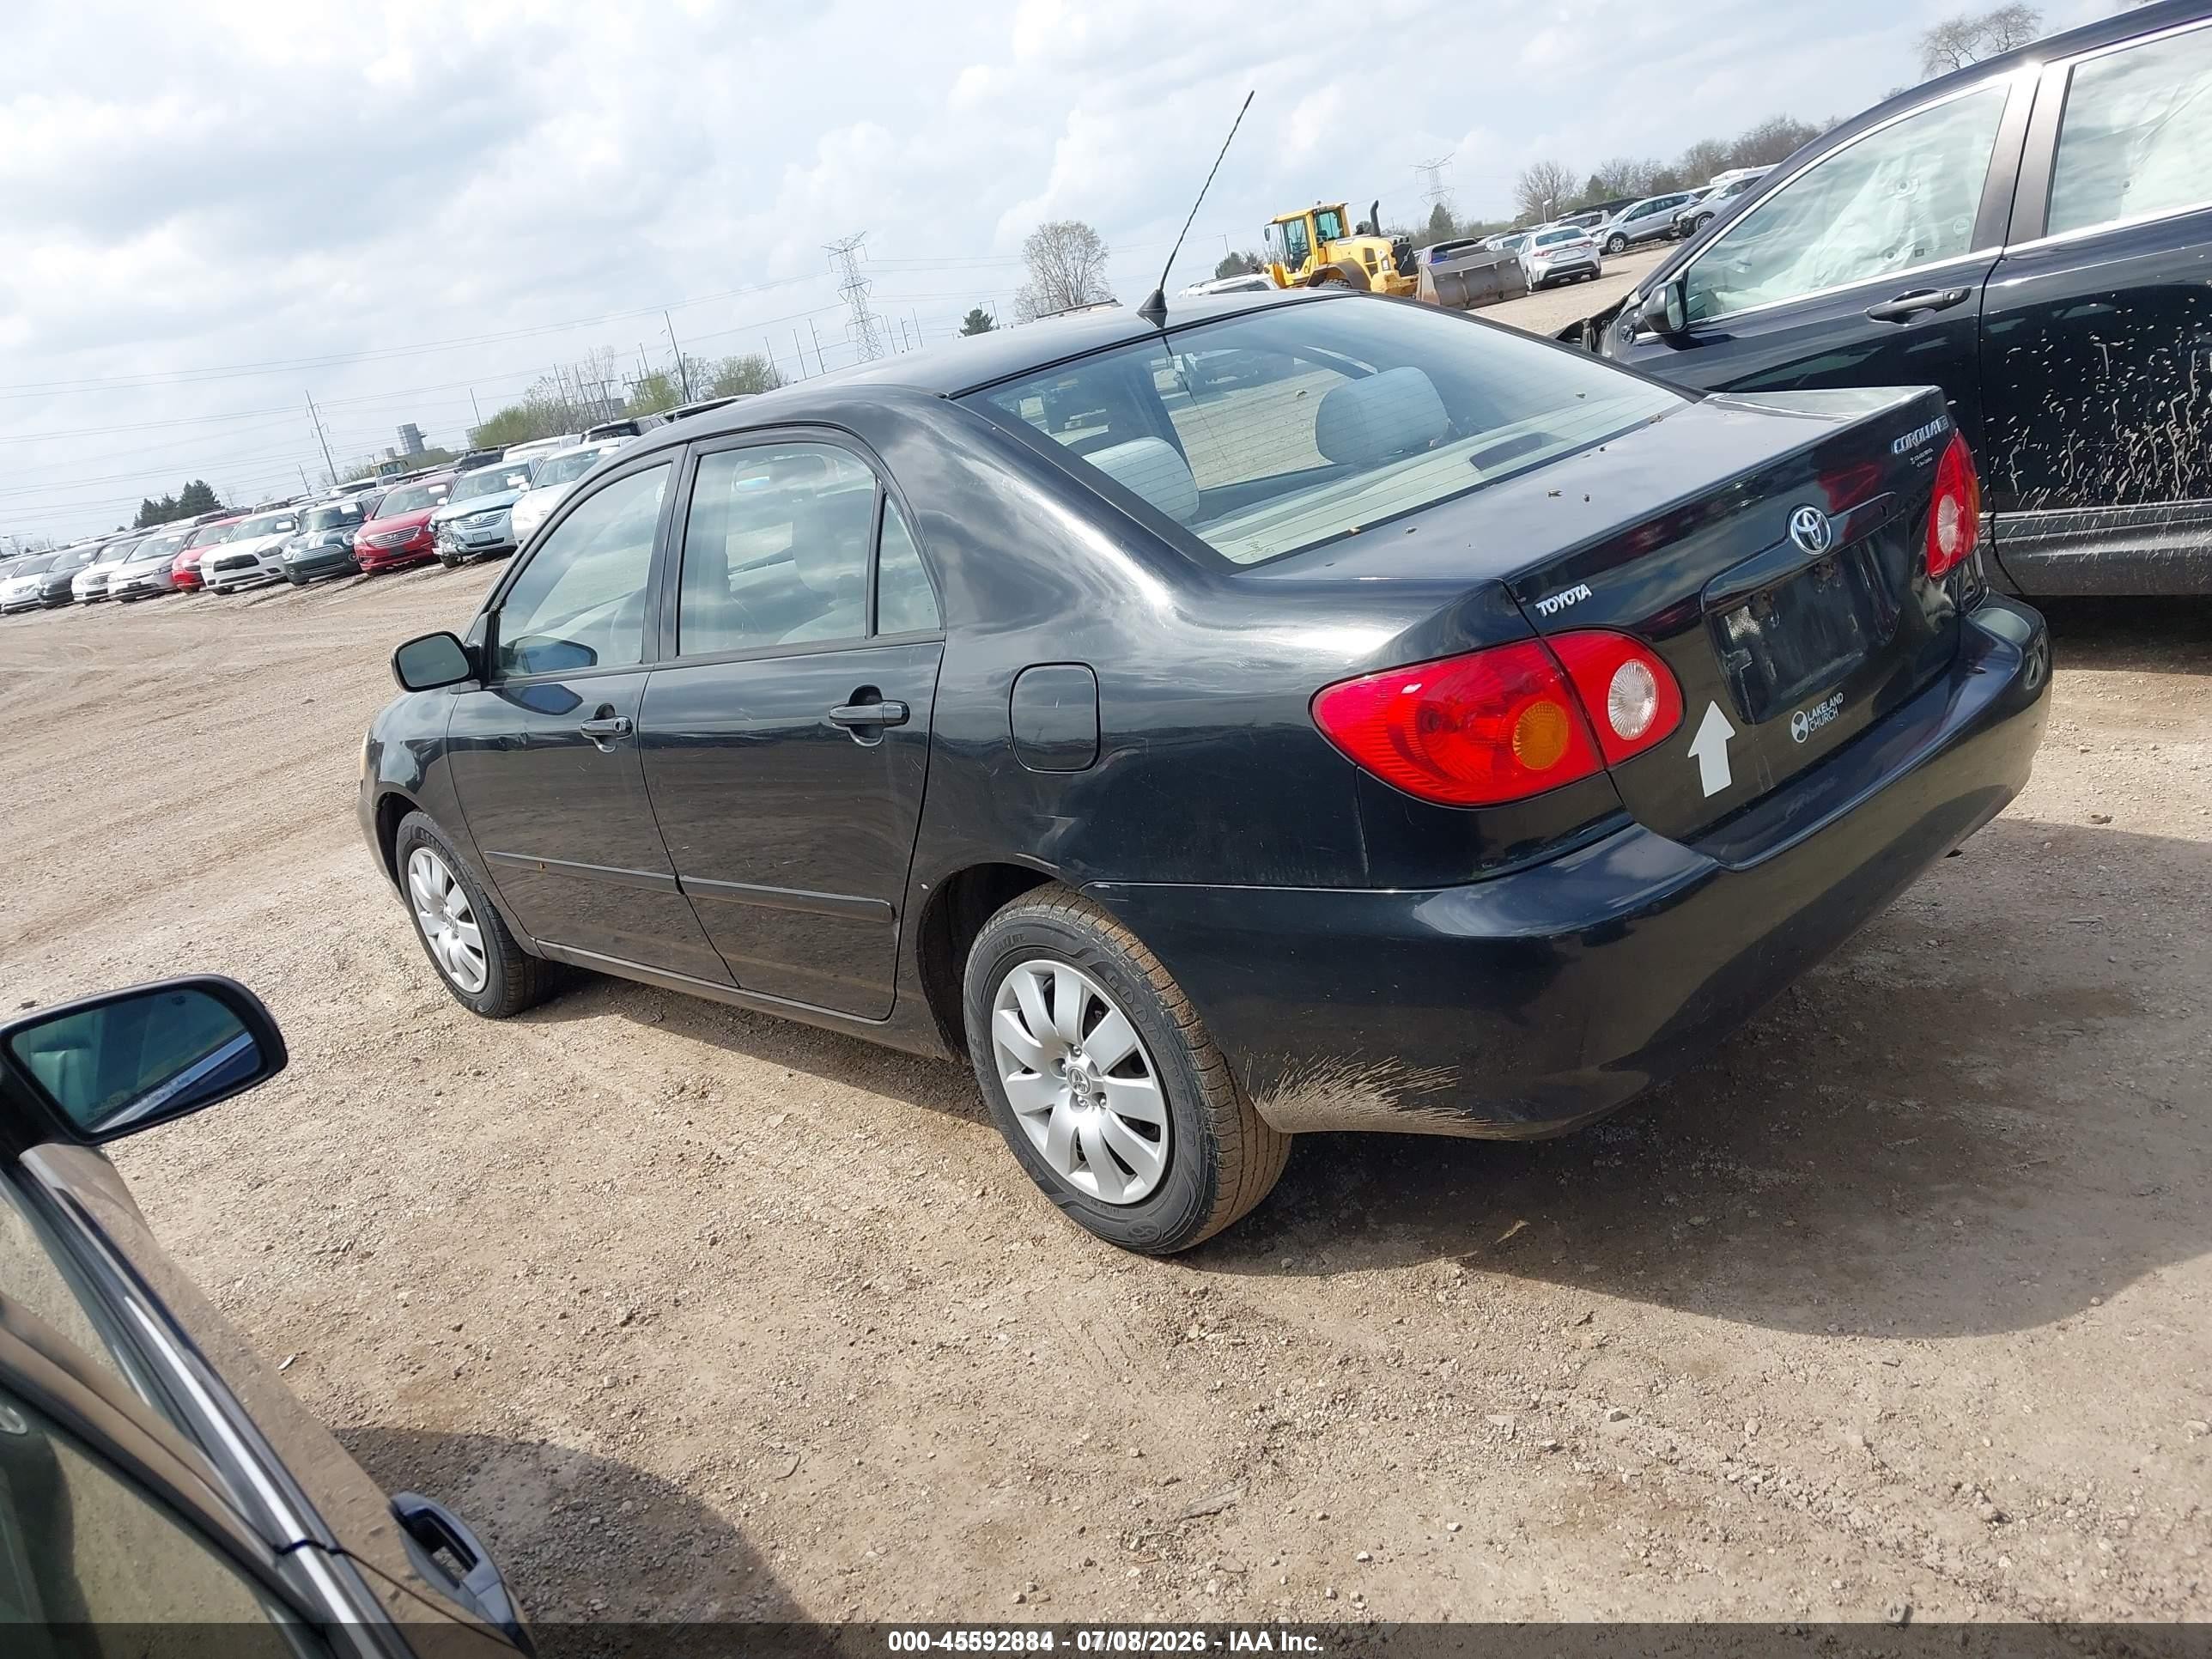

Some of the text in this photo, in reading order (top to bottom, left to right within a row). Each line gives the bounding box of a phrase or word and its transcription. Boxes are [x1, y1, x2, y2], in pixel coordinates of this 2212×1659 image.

[1891, 420, 1939, 454] COROLLA
[1534, 583, 1593, 617] TOYOTA
[1807, 692, 1844, 722] LAKELAND
[1808, 706, 1839, 732] CHURCH
